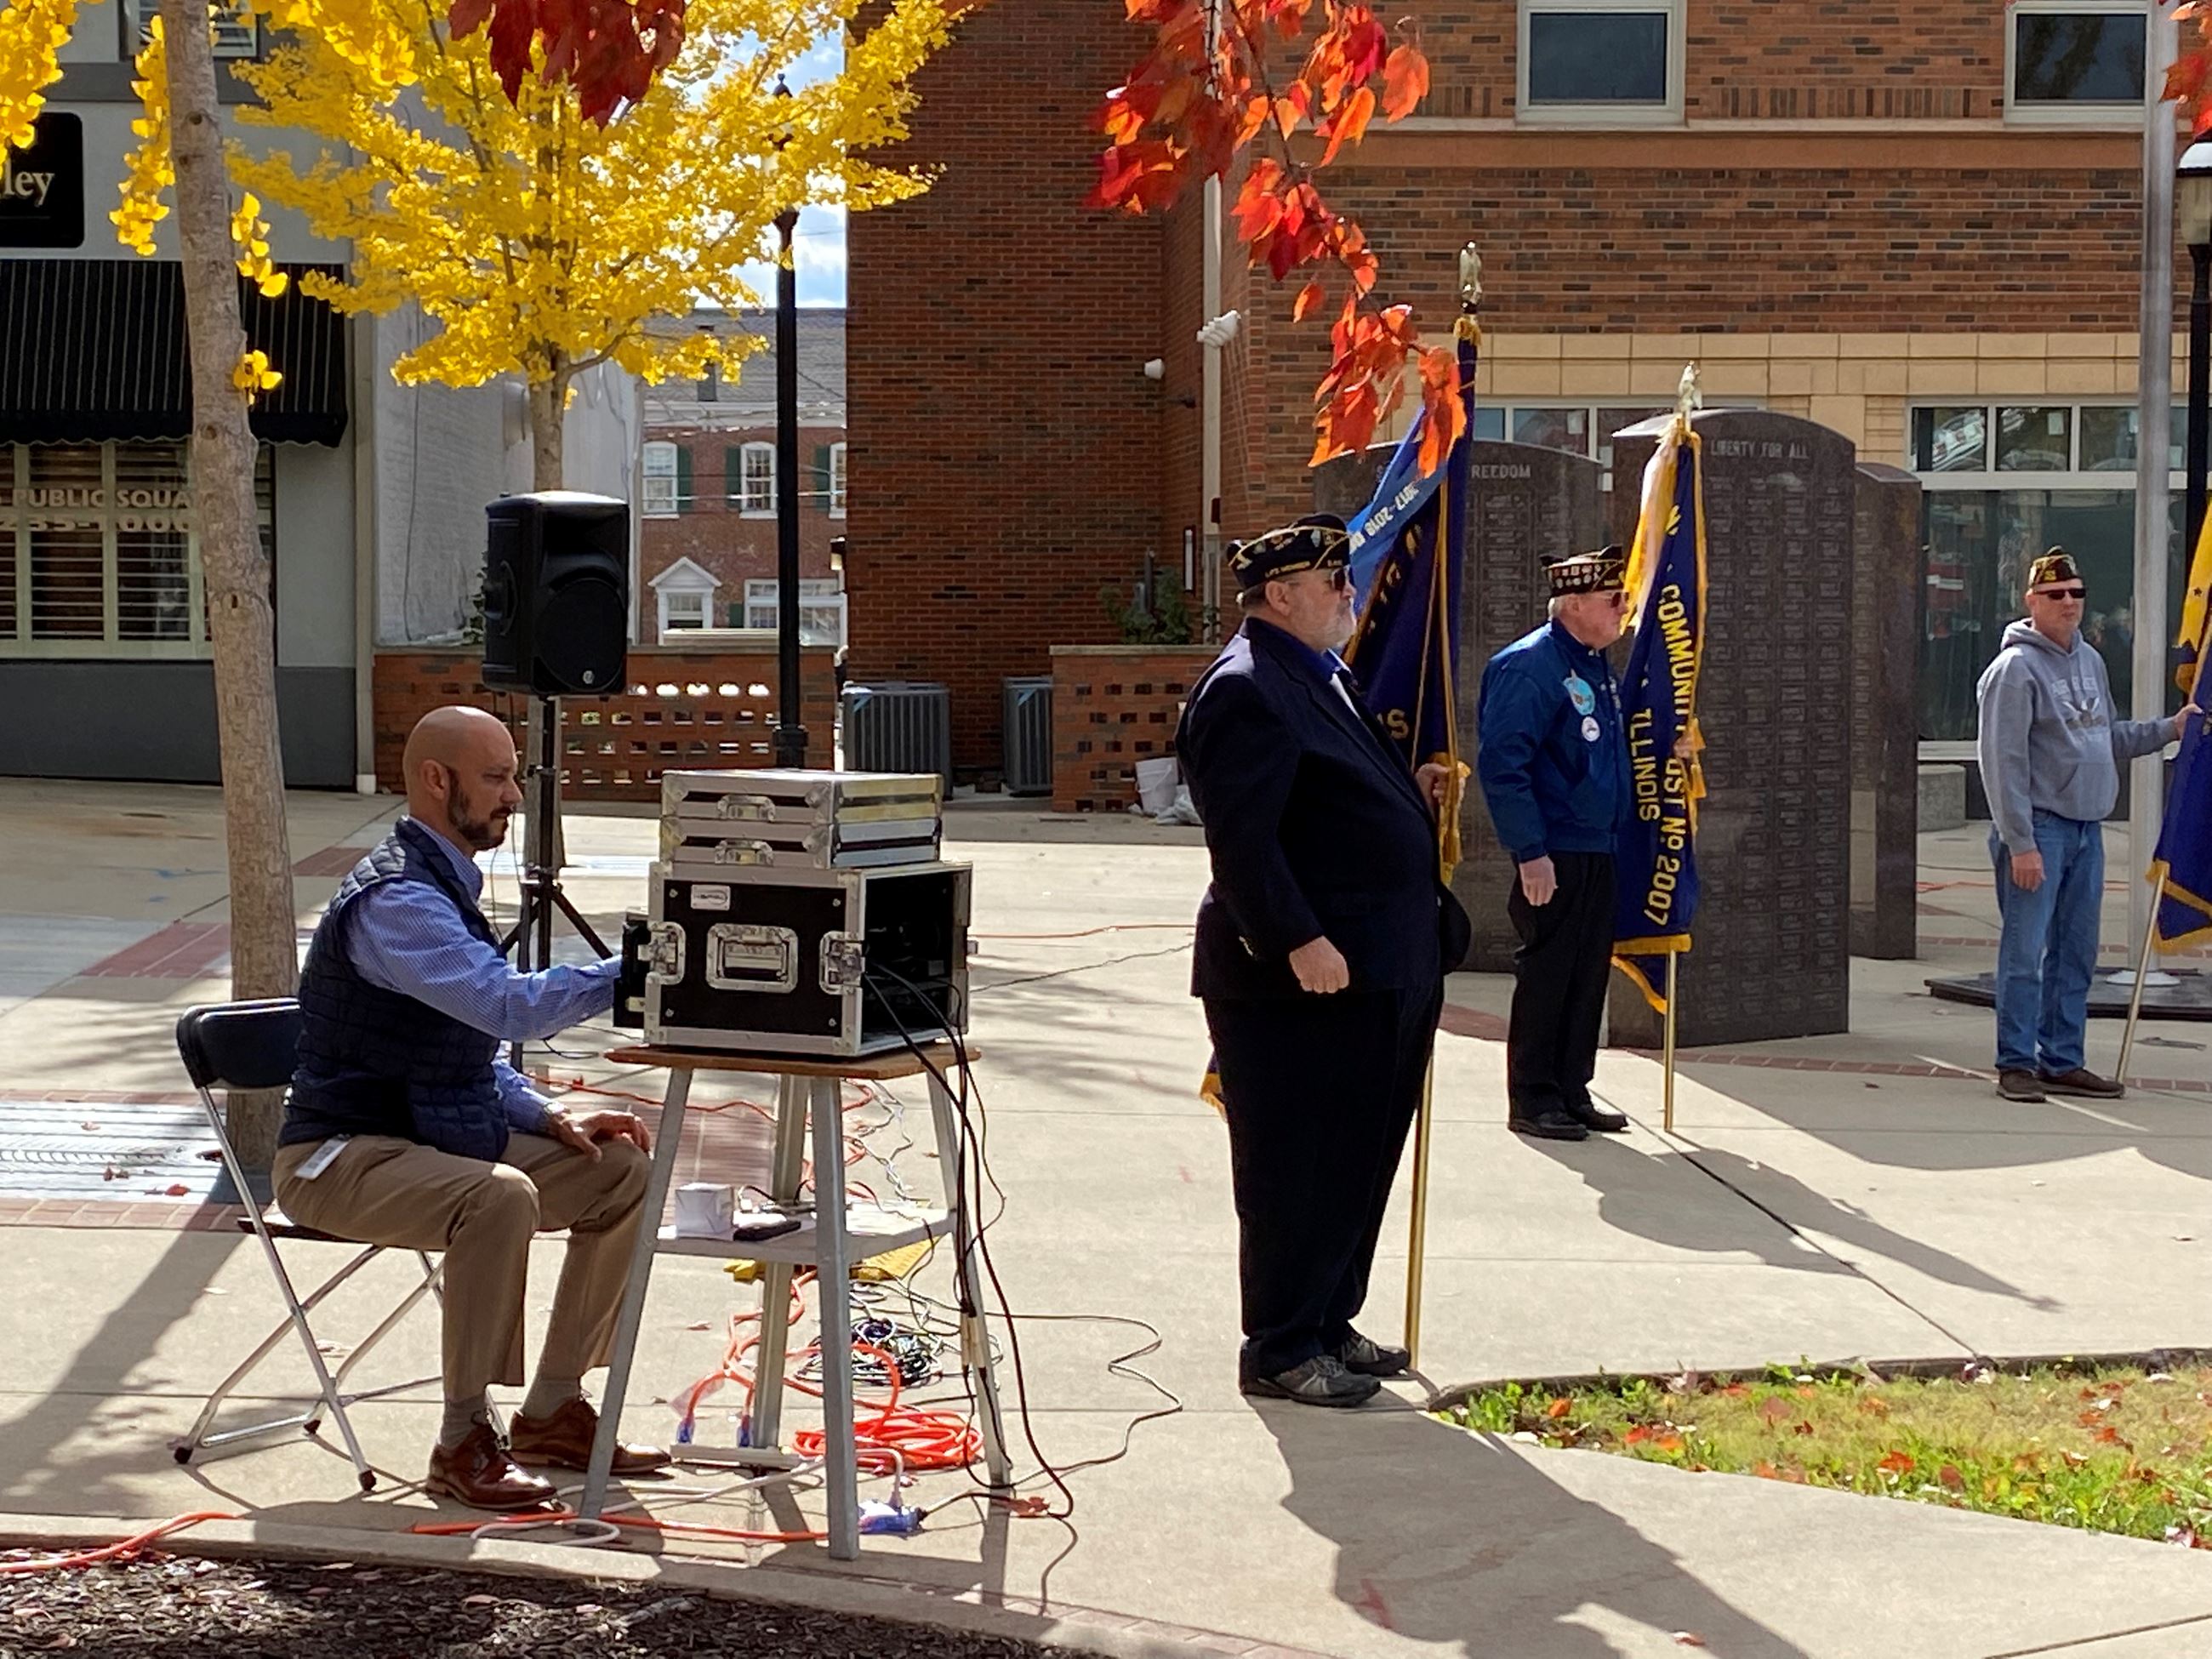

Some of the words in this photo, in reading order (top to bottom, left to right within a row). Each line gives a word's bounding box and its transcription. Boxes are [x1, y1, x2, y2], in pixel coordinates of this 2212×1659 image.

[3, 158, 55, 207] ley
[1710, 440, 1755, 458] LIBERTY
[1762, 442, 1782, 458] FOR
[1789, 442, 1809, 459] ALL
[1471, 465, 1531, 478] REEDOM
[13, 489, 105, 508] PUBLIC
[116, 489, 192, 509] SQUA
[1629, 708, 1661, 821] ILLINOIS
[1644, 854, 1680, 926] 2007
